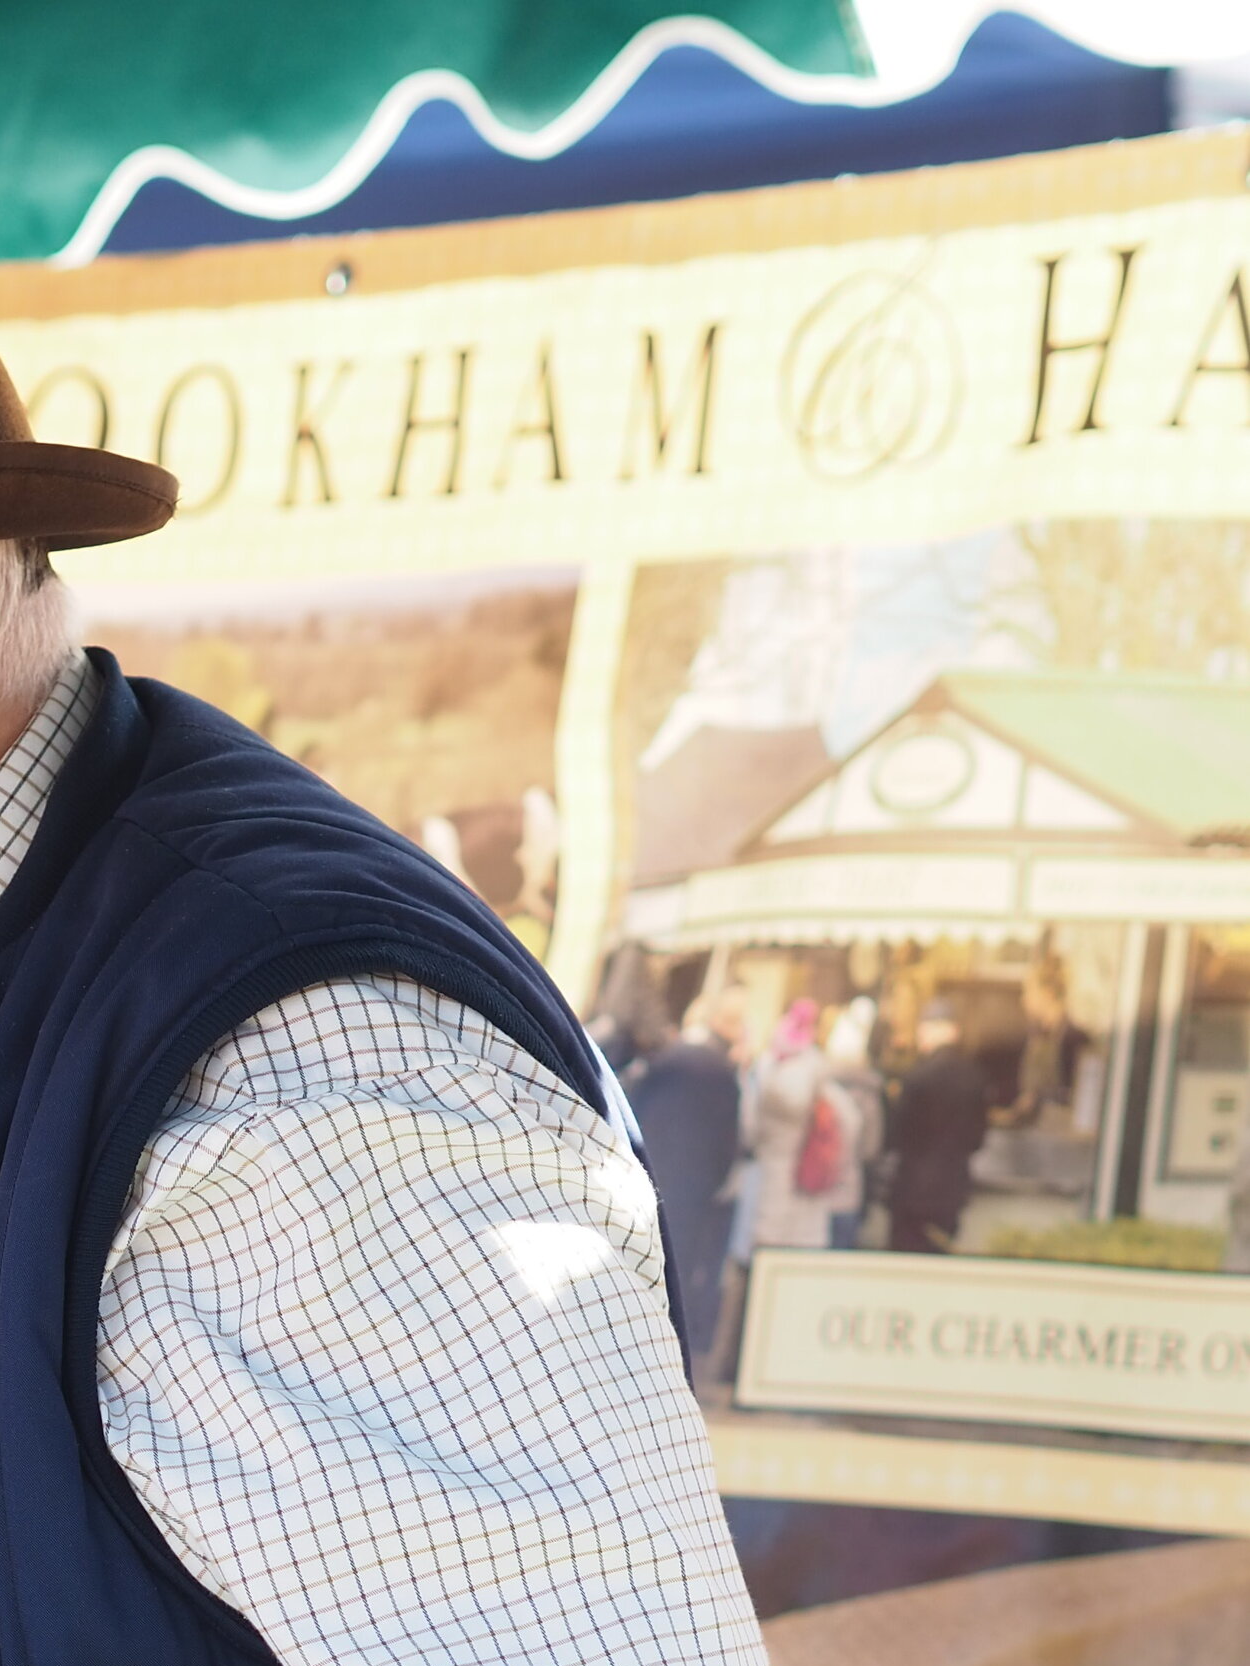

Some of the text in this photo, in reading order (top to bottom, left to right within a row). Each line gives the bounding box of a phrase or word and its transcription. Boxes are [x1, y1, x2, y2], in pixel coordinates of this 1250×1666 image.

[27, 318, 732, 518] OOKHAM
[819, 1304, 915, 1357] OUR
[929, 1311, 1187, 1376] CHARMER
